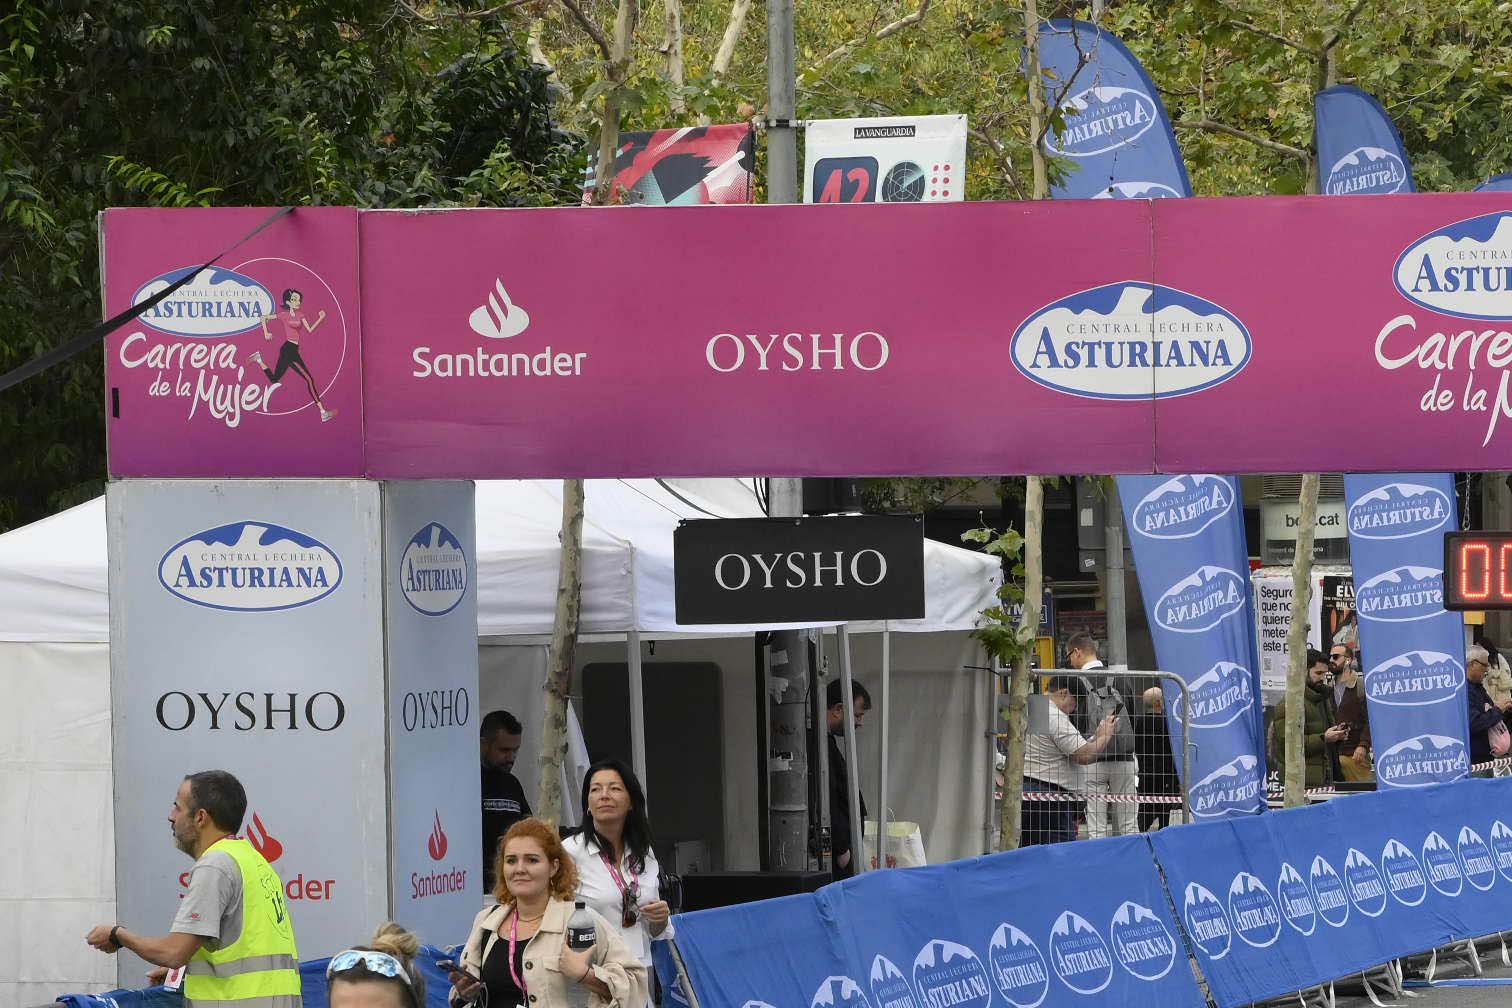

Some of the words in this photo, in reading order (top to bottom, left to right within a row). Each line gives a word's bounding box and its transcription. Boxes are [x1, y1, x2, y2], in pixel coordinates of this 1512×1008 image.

[866, 128, 914, 138] VANGUARDIA
[146, 291, 263, 318] ASTURIANA
[1066, 323, 1140, 334] CENTRAL
[1149, 322, 1224, 333] LECHERA
[119, 331, 238, 370] Carrera
[412, 346, 587, 377] Santander
[705, 331, 890, 373] OYSHO
[1029, 326, 1233, 369] ASTURIANA
[149, 371, 171, 396] de
[175, 371, 191, 396] la
[188, 366, 282, 428] Mujer
[1420, 374, 1454, 412] de
[1464, 372, 1487, 412] la
[173, 555, 329, 589] ASTURIANA
[201, 553, 258, 561] CENTRAL
[265, 552, 323, 561] LECHERA
[714, 549, 888, 591] OYSHO
[406, 557, 463, 592] ASTURIANA
[1262, 602, 1277, 613] que
[1263, 641, 1281, 652] este
[156, 691, 345, 731] OYSHO
[402, 687, 469, 732] OYSHO
[411, 868, 467, 899] Santander
[994, 957, 1046, 990] ASTURIANA
[1056, 943, 1110, 977] ASTURIANA
